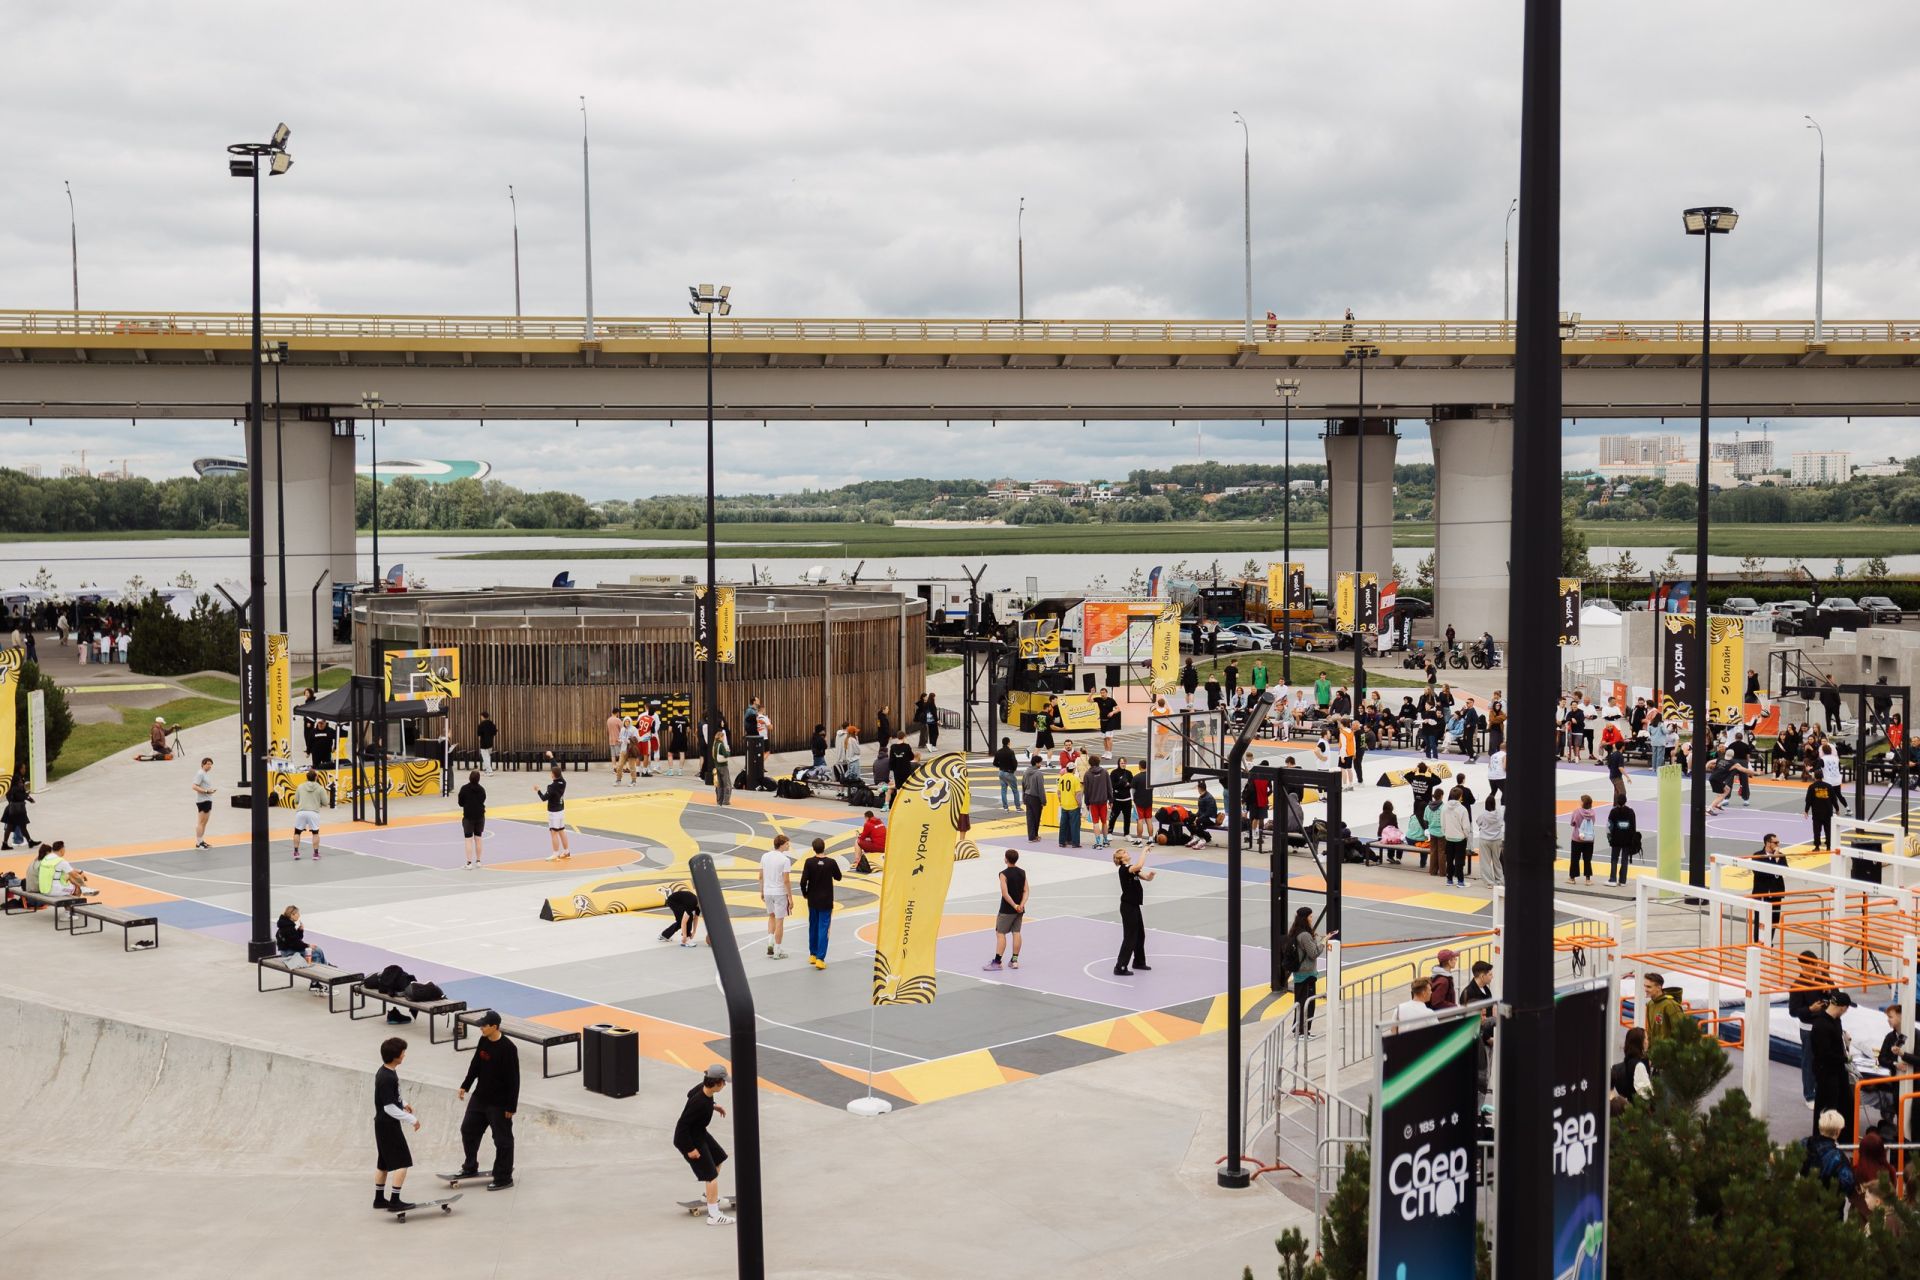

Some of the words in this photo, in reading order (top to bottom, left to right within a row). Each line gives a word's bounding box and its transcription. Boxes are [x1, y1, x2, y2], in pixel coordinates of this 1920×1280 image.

[1566, 596, 1574, 619] урам
[1163, 631, 1172, 661] билайн
[1675, 643, 1687, 678] урам
[1722, 645, 1732, 683] билайн
[639, 719, 650, 732] 99
[1060, 779, 1071, 792] 10
[915, 823, 930, 862] урам
[1553, 1107, 1596, 1149] бер
[1388, 1143, 1468, 1196] Сбер
[1553, 1135, 1598, 1177] пот
